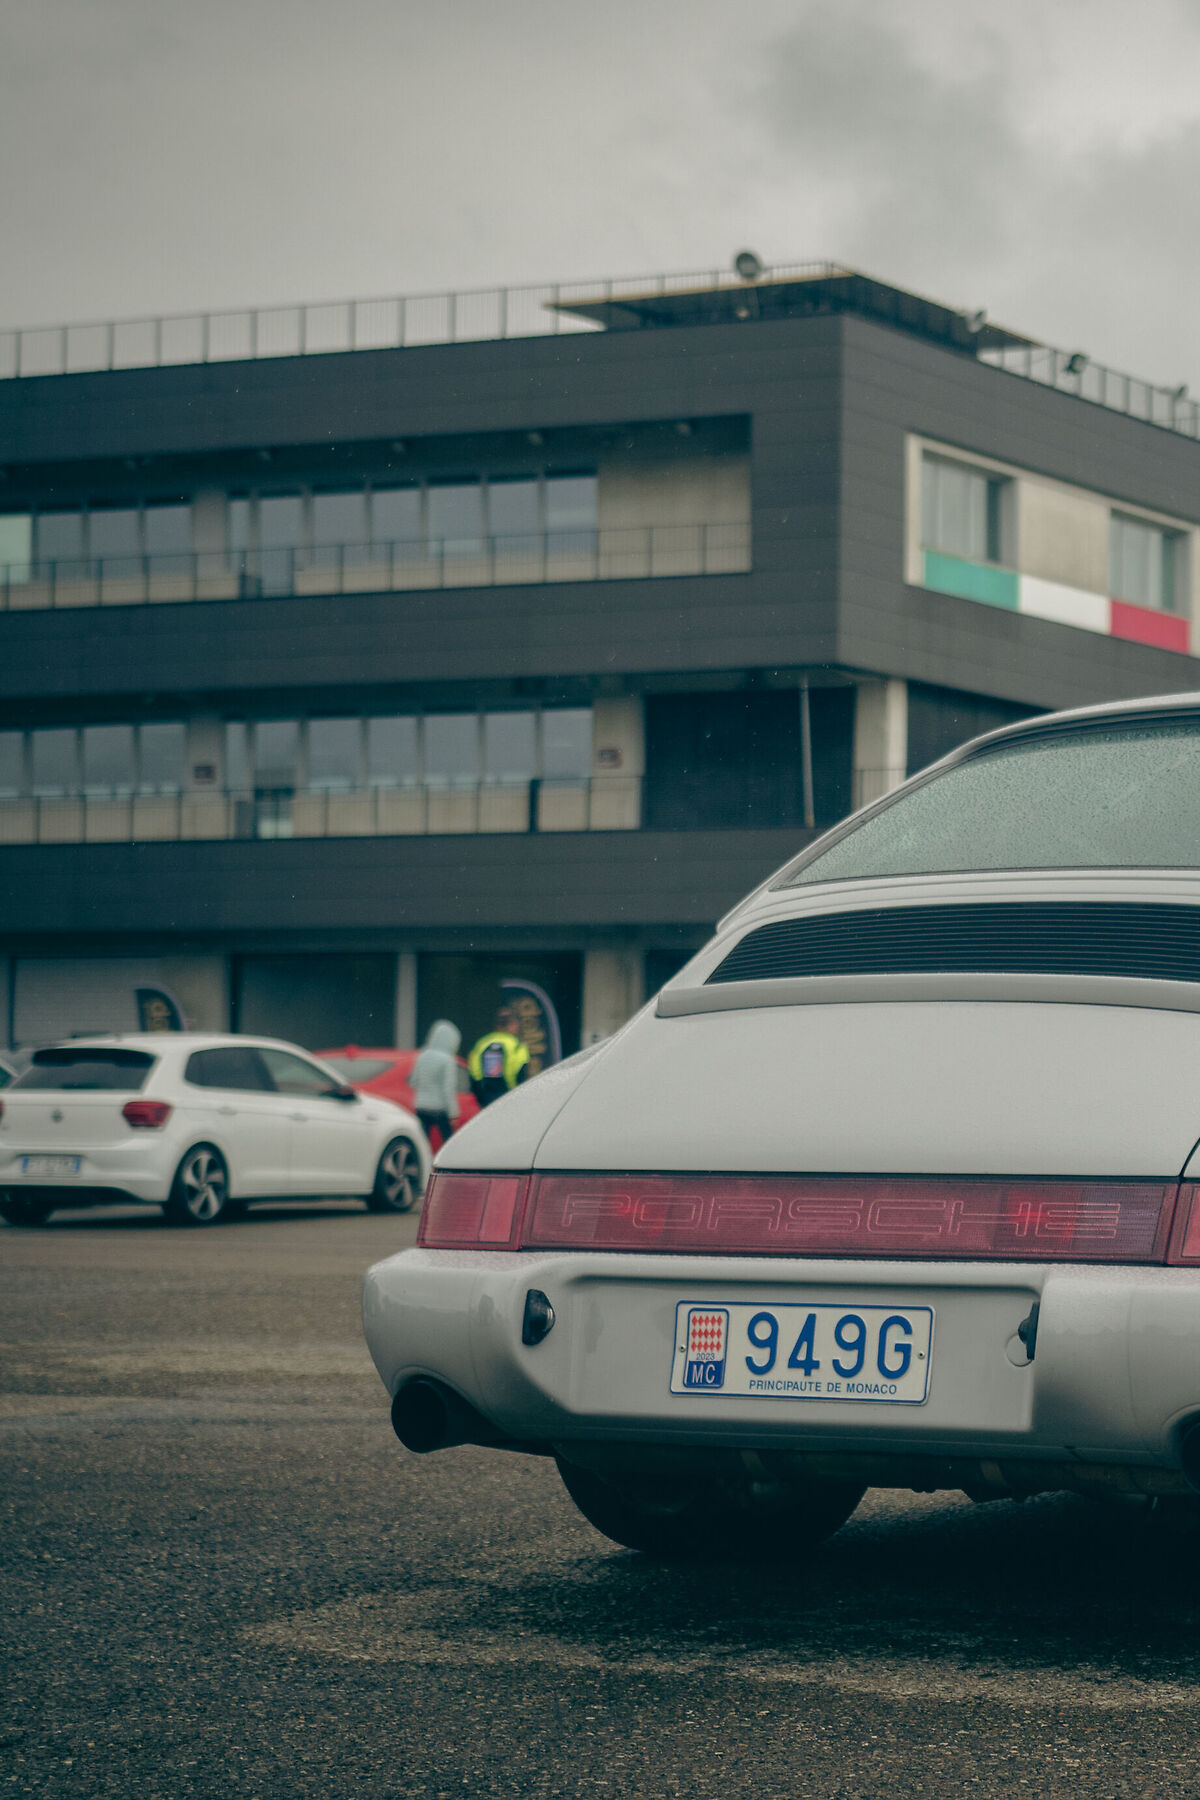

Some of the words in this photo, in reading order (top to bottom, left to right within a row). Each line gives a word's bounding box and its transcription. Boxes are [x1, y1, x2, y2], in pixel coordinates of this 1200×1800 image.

[561, 1193, 1121, 1239] PORSCHE
[745, 1311, 913, 1379] 949G
[696, 1352, 716, 1361] 2023
[692, 1363, 716, 1384] MC
[749, 1379, 822, 1393] PRINCIPAUTE
[827, 1383, 841, 1393] DE
[846, 1383, 898, 1395] MONACO
